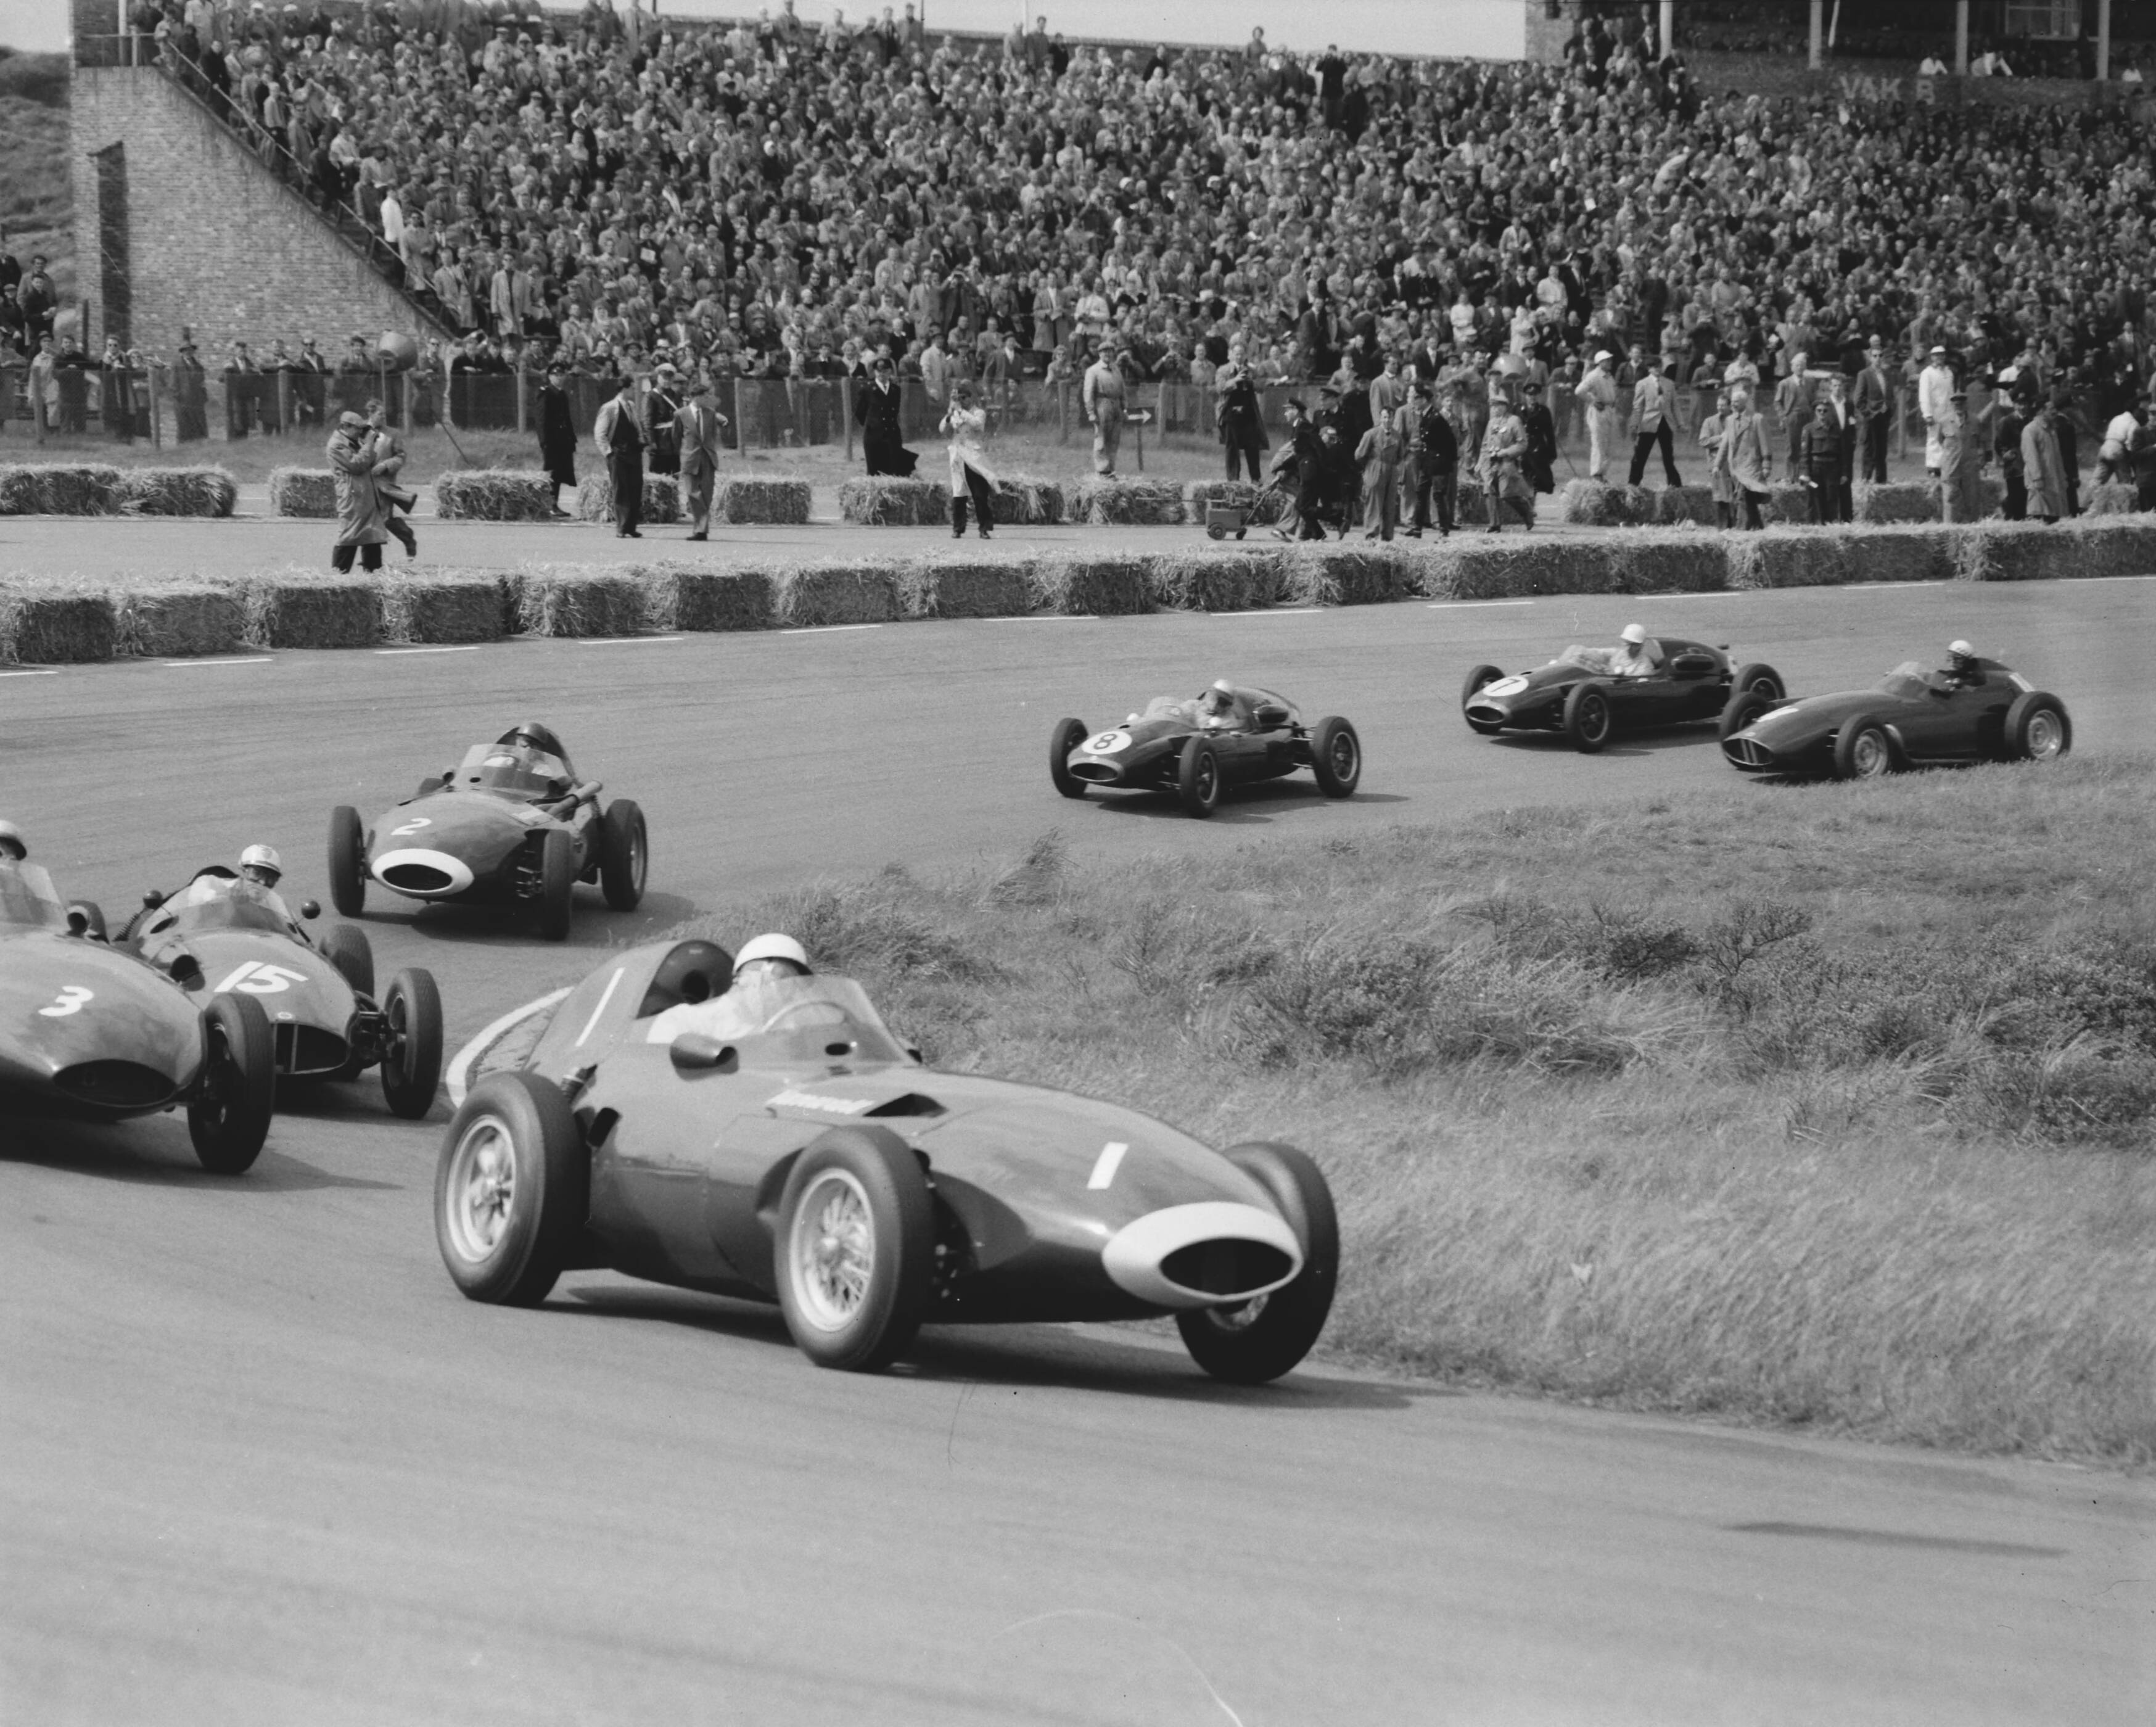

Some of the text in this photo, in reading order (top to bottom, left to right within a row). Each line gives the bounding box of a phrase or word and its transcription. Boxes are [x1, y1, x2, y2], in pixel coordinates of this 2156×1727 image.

[1840, 75, 1901, 104] VAK
[1489, 678, 1521, 693] 7
[1093, 733, 1117, 749] 8
[391, 818, 432, 835] 2
[214, 961, 308, 994] 15
[39, 986, 94, 1016] 3
[576, 967, 625, 1047] 1
[1087, 1142, 1129, 1189] 1
